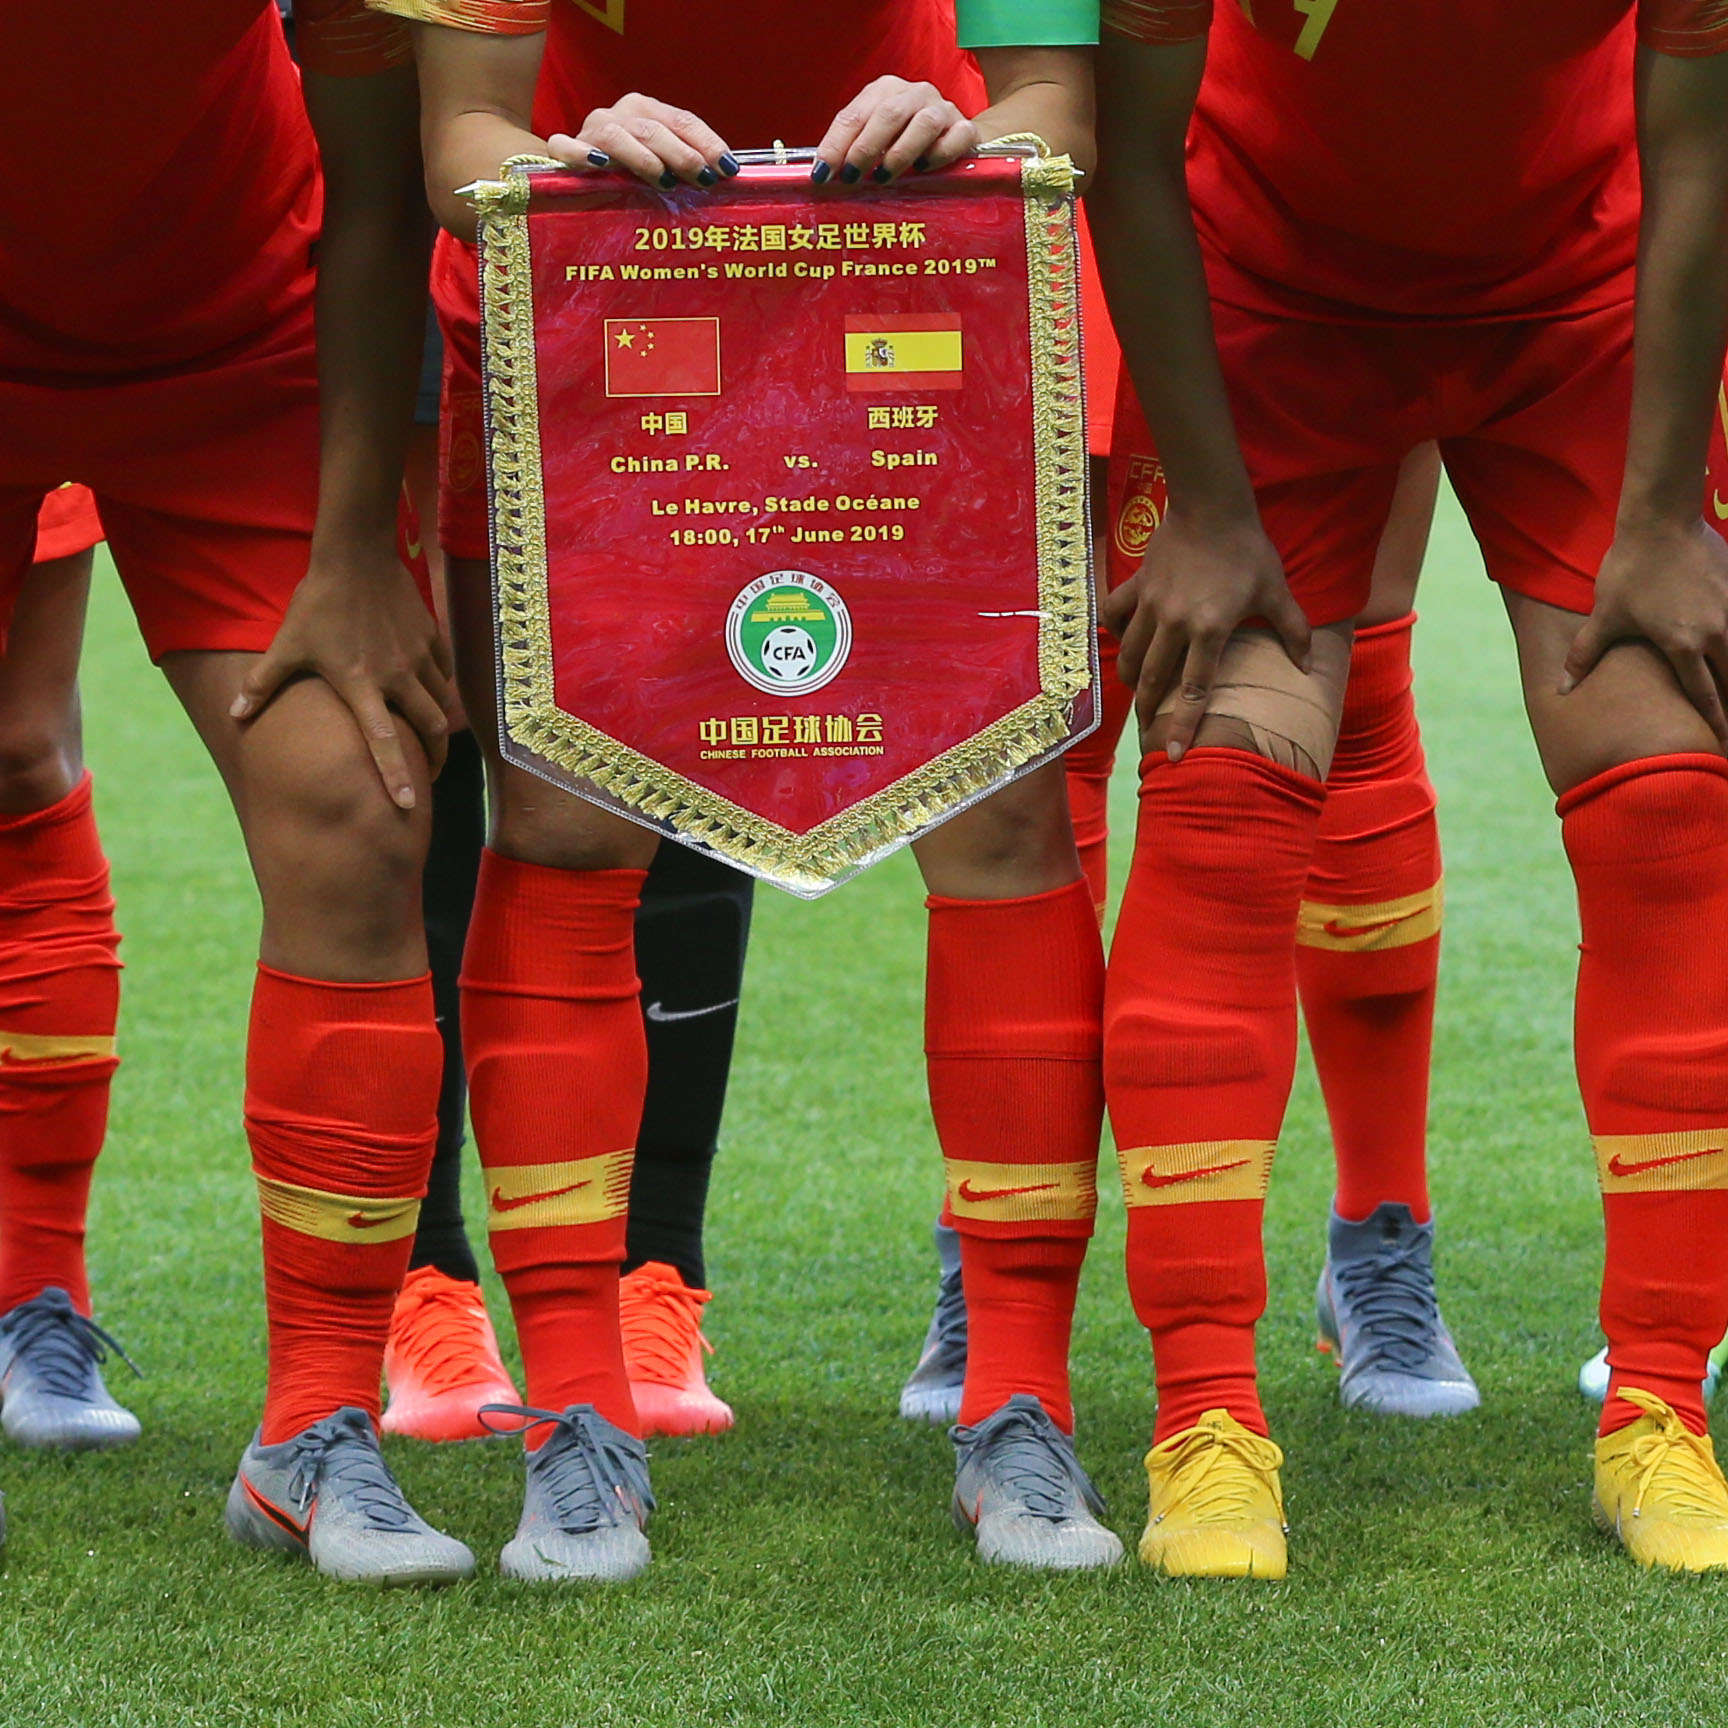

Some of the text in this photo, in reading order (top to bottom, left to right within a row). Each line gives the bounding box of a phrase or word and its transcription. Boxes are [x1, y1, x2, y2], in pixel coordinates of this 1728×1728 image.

[634, 222, 927, 253] 2019年法国女足世界杯
[565, 265, 615, 281] FIFA
[620, 263, 719, 280] Women's
[724, 262, 788, 278] World
[793, 262, 836, 280] Cup
[841, 260, 918, 276] France
[640, 411, 688, 436] 中国
[867, 405, 939, 430] 西班牙
[610, 454, 729, 473] China P.R.
[783, 454, 818, 469] vs.
[870, 449, 939, 470] Spain
[651, 494, 921, 516] Le Havre, Stade Océane
[669, 524, 905, 548] 18:00, 17th June 2019
[772, 645, 807, 661] CFA
[698, 713, 884, 747] 中国足球协会
[699, 745, 885, 760] CHINESE FOOTBALL ASSOCIATION
